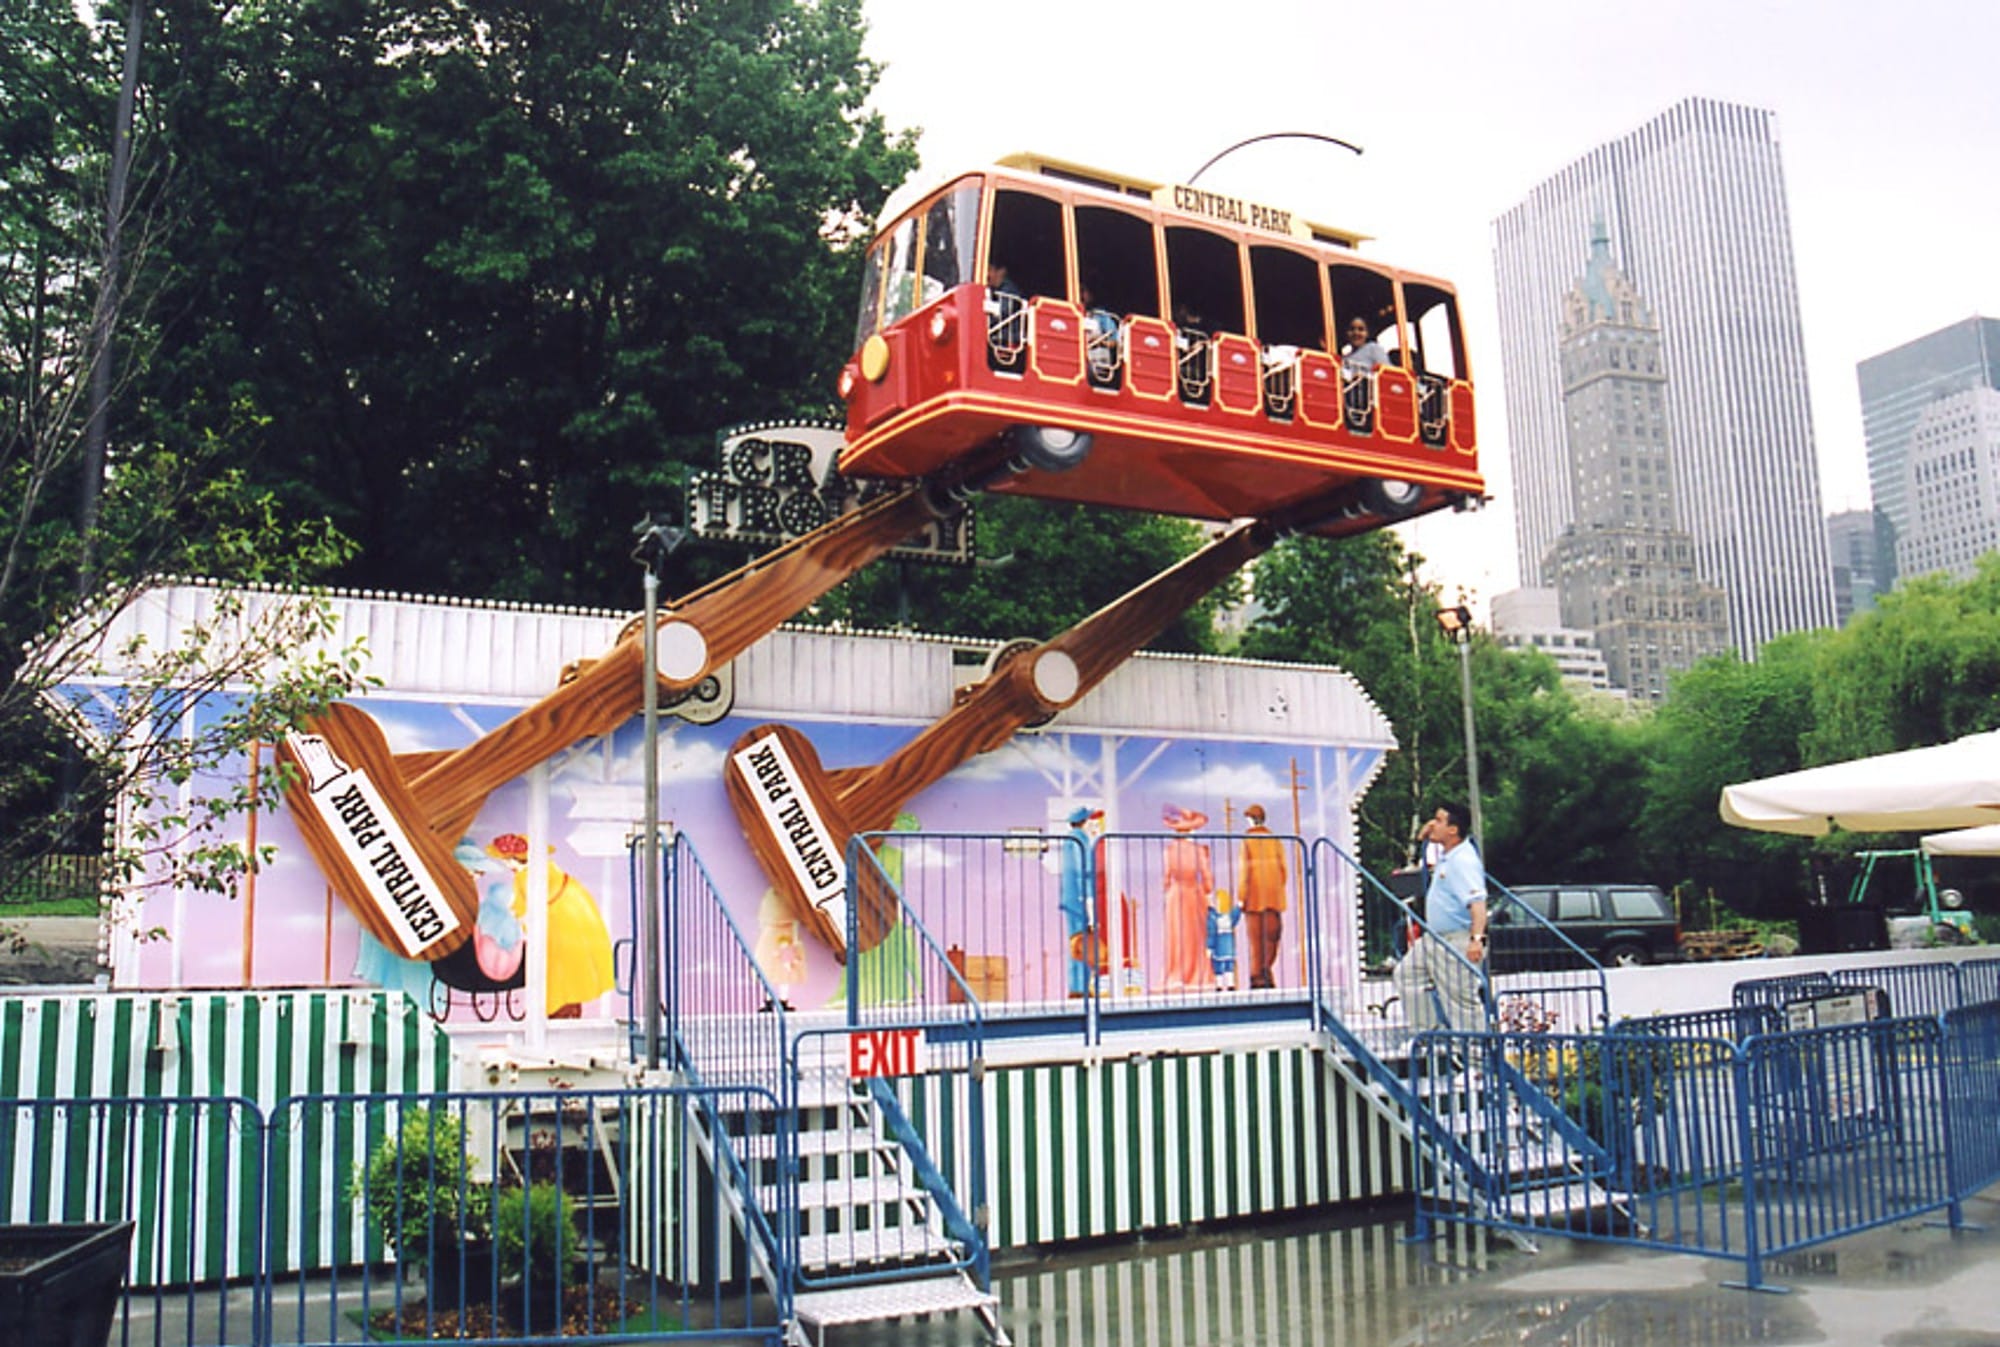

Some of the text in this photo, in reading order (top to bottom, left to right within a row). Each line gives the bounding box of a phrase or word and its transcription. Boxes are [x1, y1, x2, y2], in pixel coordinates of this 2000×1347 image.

[1174, 185, 1293, 236] CENTRAL PARK
[330, 783, 446, 943] CENTRAL PARK
[747, 743, 839, 890] CENTRAL PARK
[850, 1029, 920, 1078] EXIT
